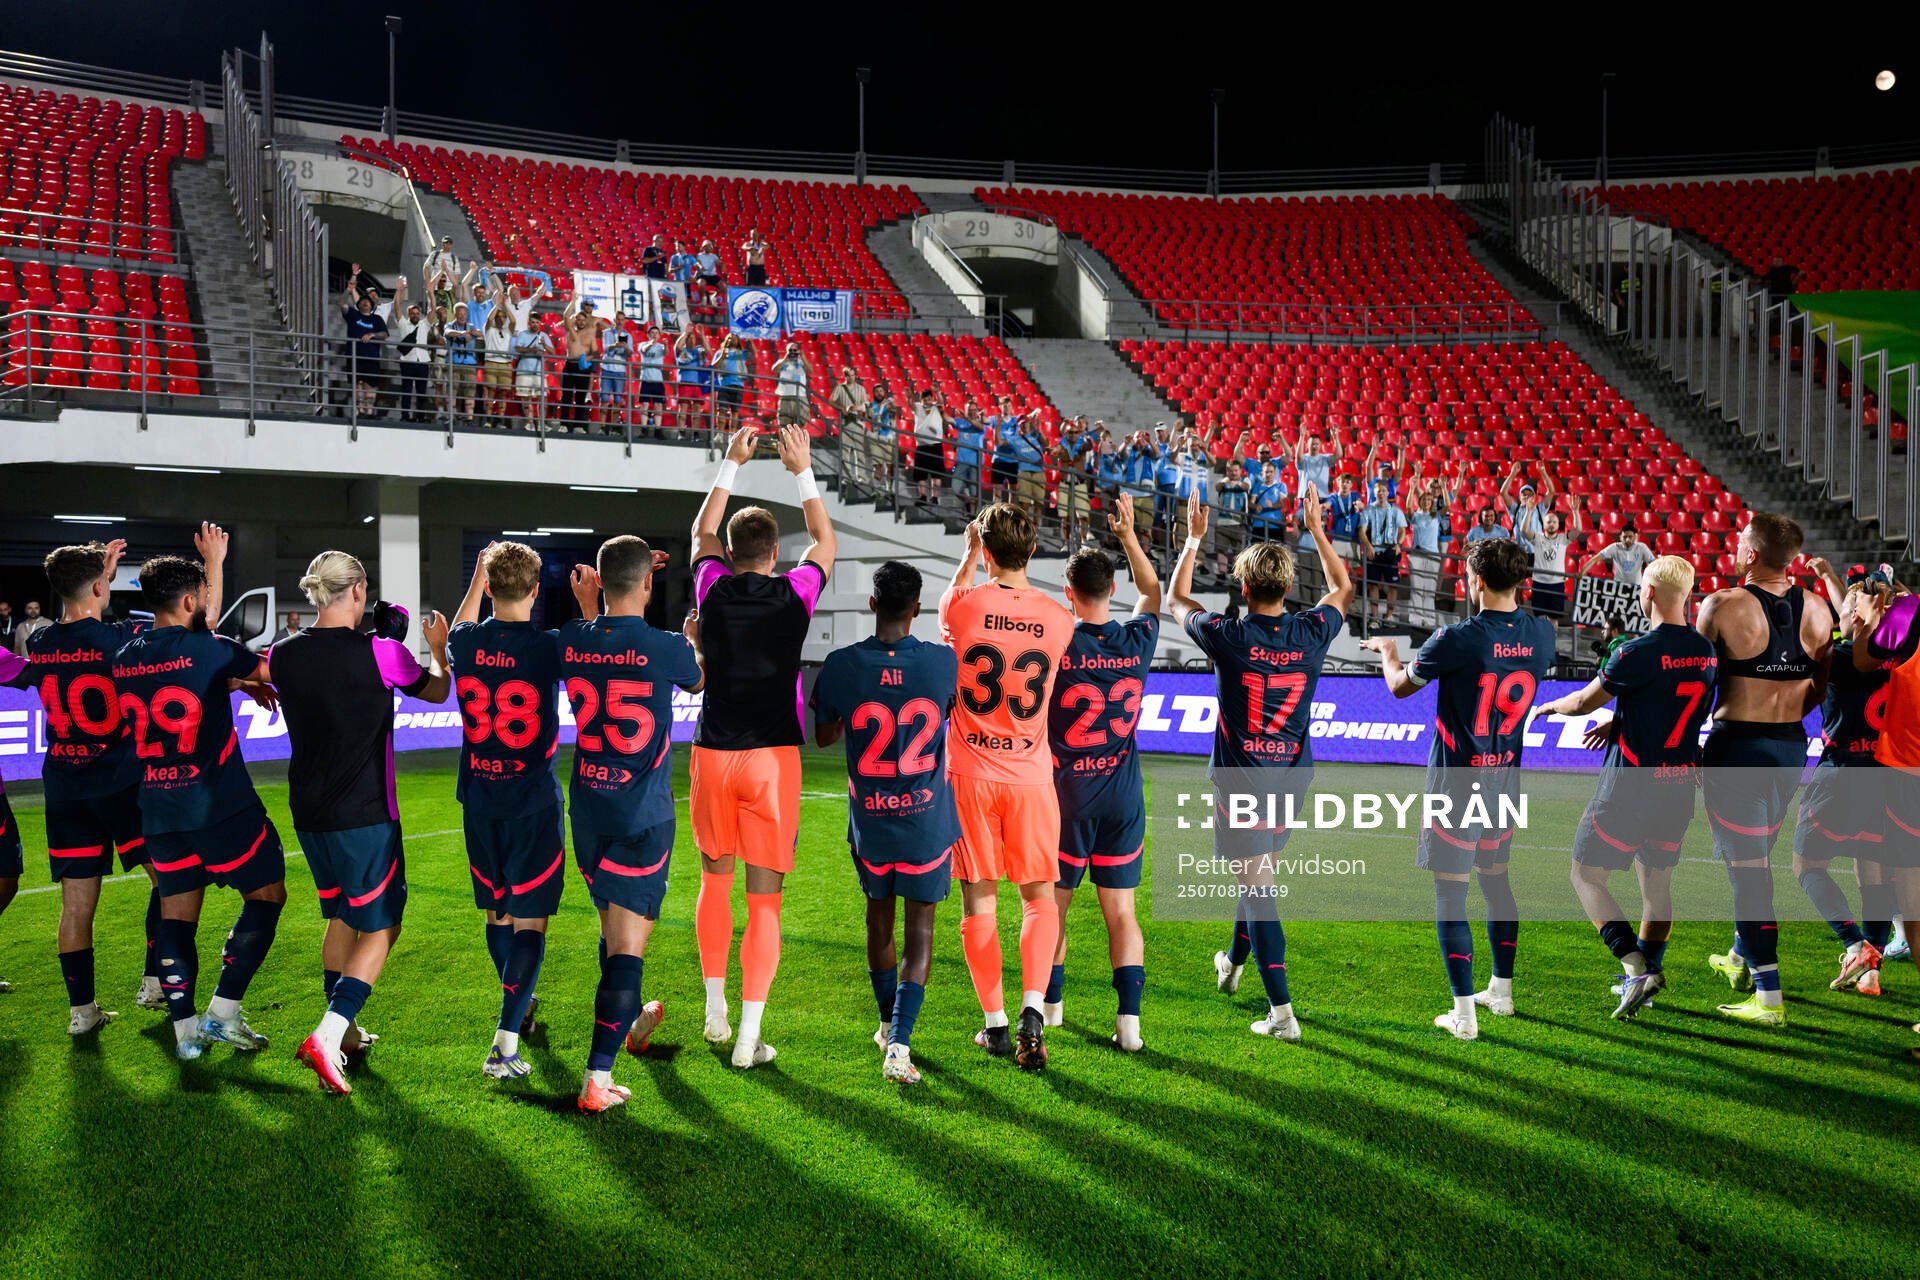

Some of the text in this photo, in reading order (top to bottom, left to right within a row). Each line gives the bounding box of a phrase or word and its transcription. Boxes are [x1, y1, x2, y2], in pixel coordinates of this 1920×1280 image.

[346, 166, 374, 188] 29
[965, 220, 1035, 239] 29 30
[984, 614, 1044, 639] Ellborg
[1573, 607, 1653, 634] MAMØ
[475, 649, 516, 668] Bolin
[565, 646, 649, 668] Busanello
[1249, 646, 1304, 666] Stryger
[1493, 642, 1534, 658] Rösler
[112, 656, 193, 678] aksabanovic
[1061, 654, 1141, 670] B. Johnsen
[1756, 664, 1807, 673] CATAPULT
[879, 668, 903, 686] Ali
[960, 643, 1052, 720] 33
[40, 673, 121, 739] 40
[456, 675, 541, 750] 38
[1060, 678, 1143, 748] 23
[1242, 672, 1307, 734] 17
[1474, 670, 1537, 736] 19
[118, 686, 203, 759] 29
[566, 676, 656, 755] 25
[1664, 681, 1707, 748] 7
[851, 697, 941, 778] 22
[966, 732, 1013, 751] akea
[1243, 736, 1286, 754] akea
[1073, 755, 1118, 771] akea
[1653, 762, 1689, 779] akea
[864, 791, 913, 811] akea
